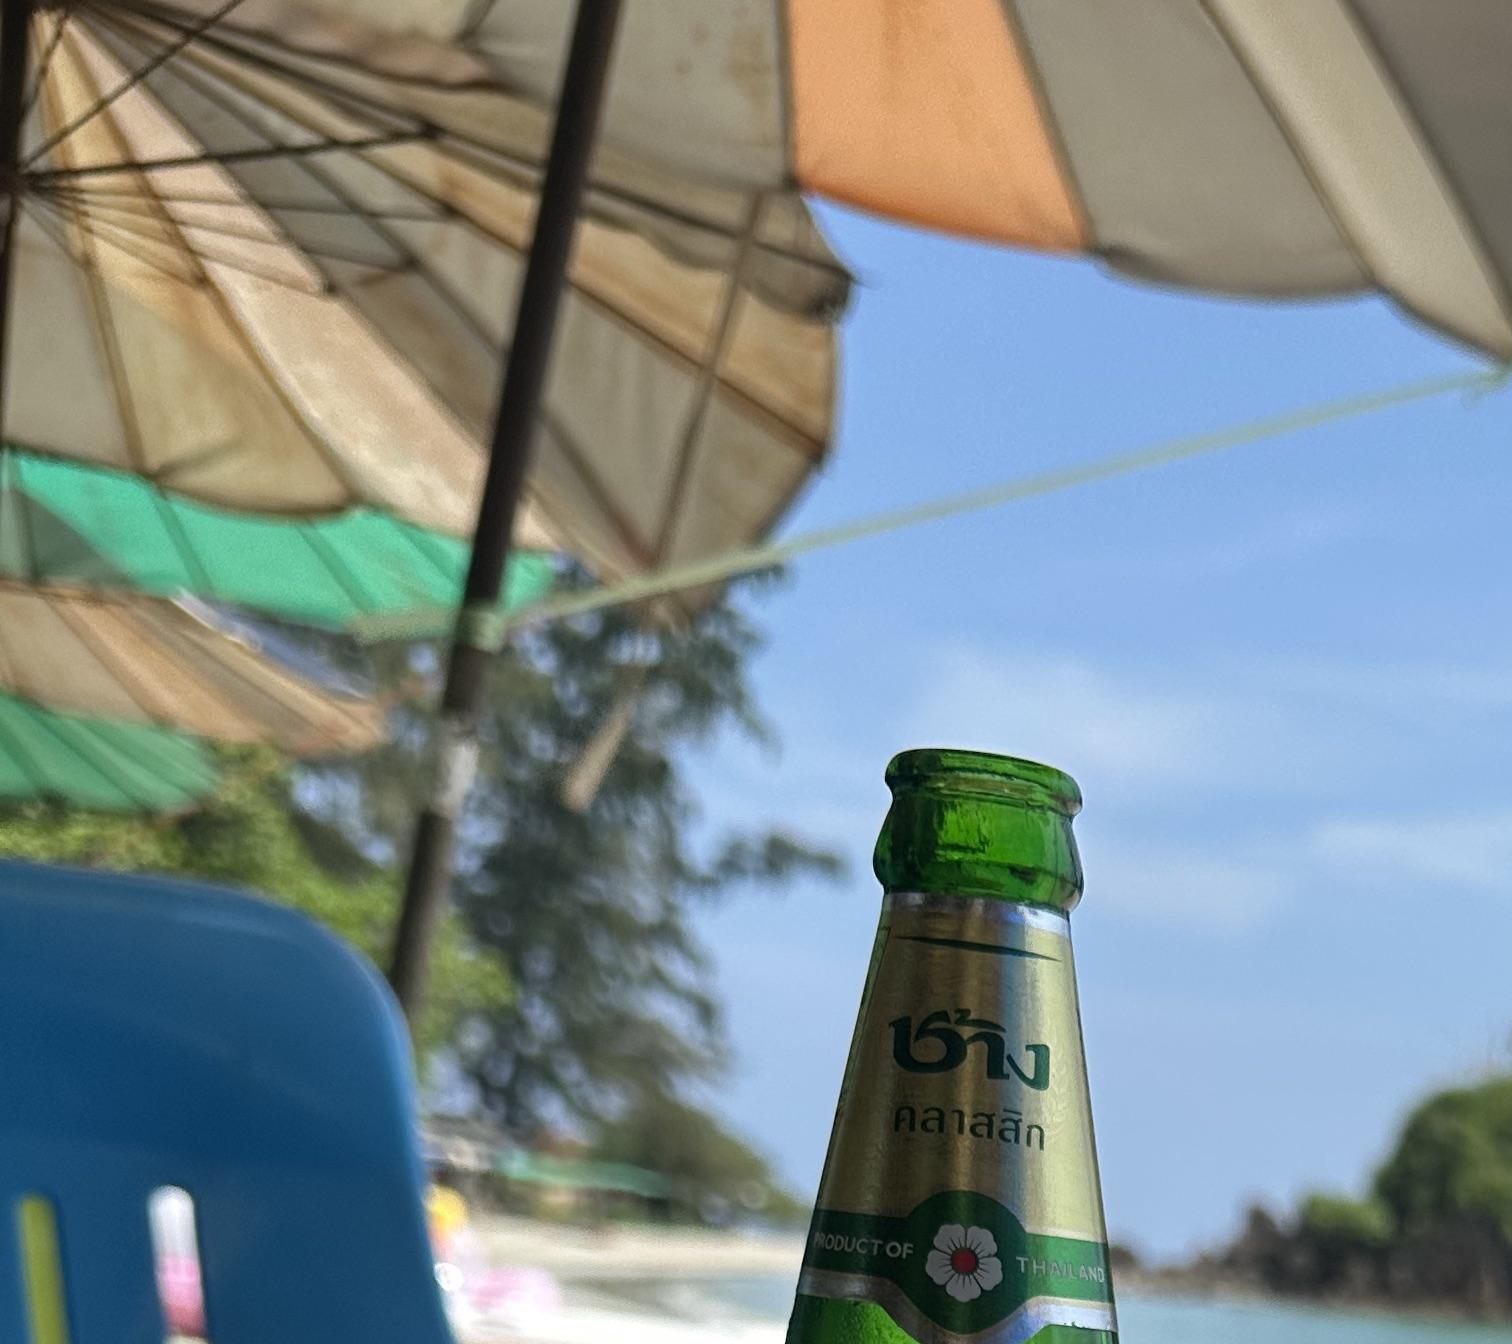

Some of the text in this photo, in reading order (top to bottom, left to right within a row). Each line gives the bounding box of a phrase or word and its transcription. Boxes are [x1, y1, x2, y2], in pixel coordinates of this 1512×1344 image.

[888, 1008, 1051, 1091] ช้าง
[894, 1105, 1045, 1151] คลาสสิก
[813, 1231, 1105, 1283] PRODUCT OF THAILAND
